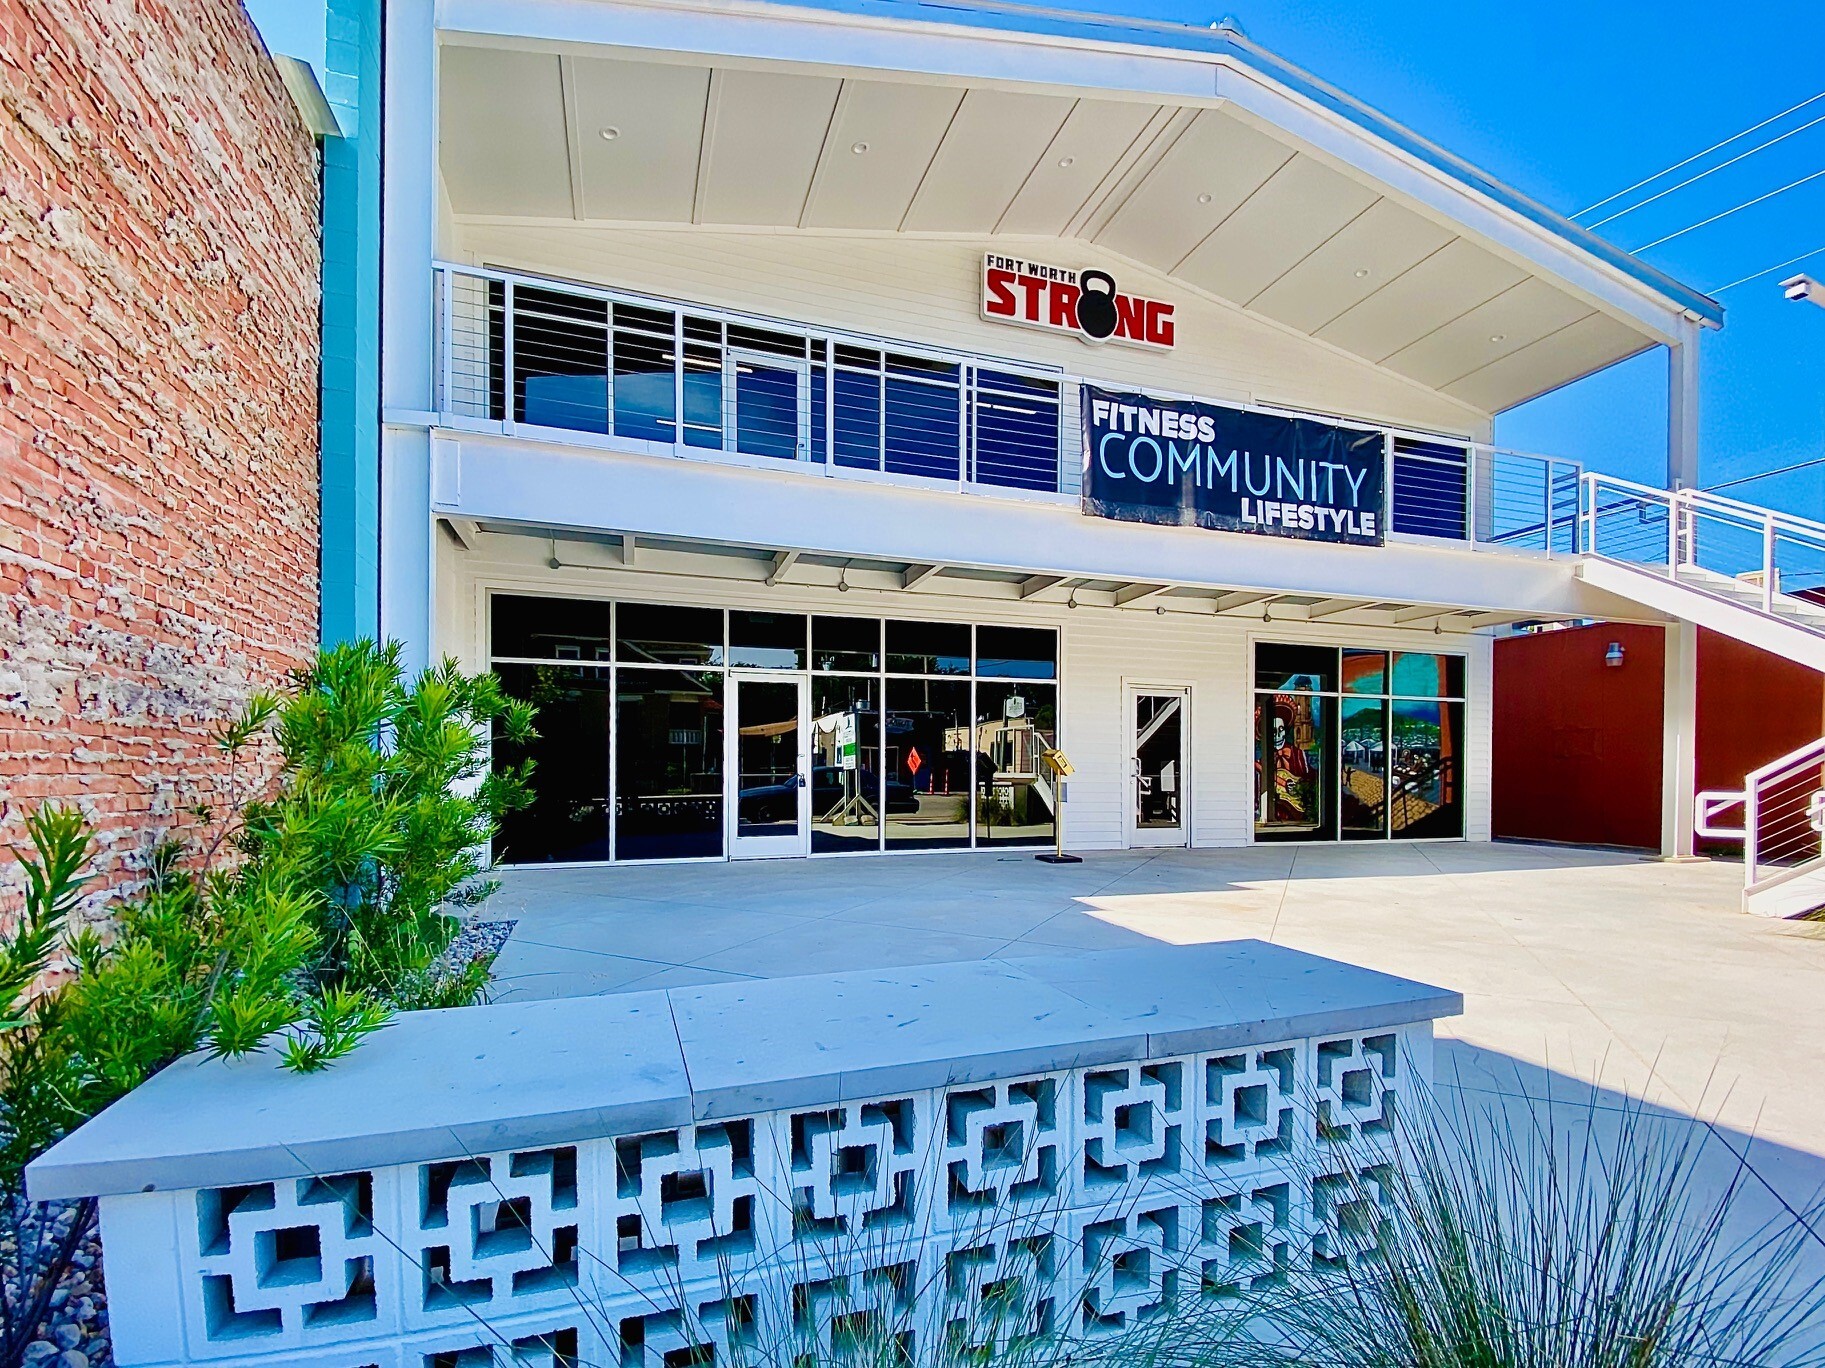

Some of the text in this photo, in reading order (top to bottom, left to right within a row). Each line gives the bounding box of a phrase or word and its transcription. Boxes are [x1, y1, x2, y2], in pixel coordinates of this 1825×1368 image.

[987, 254, 1076, 284] FORT WORTH
[987, 268, 1175, 346] STRONG
[1092, 399, 1216, 443] FITNESS
[1100, 432, 1367, 508] COMMUNITY
[1241, 497, 1376, 537] LIFESTYLE
